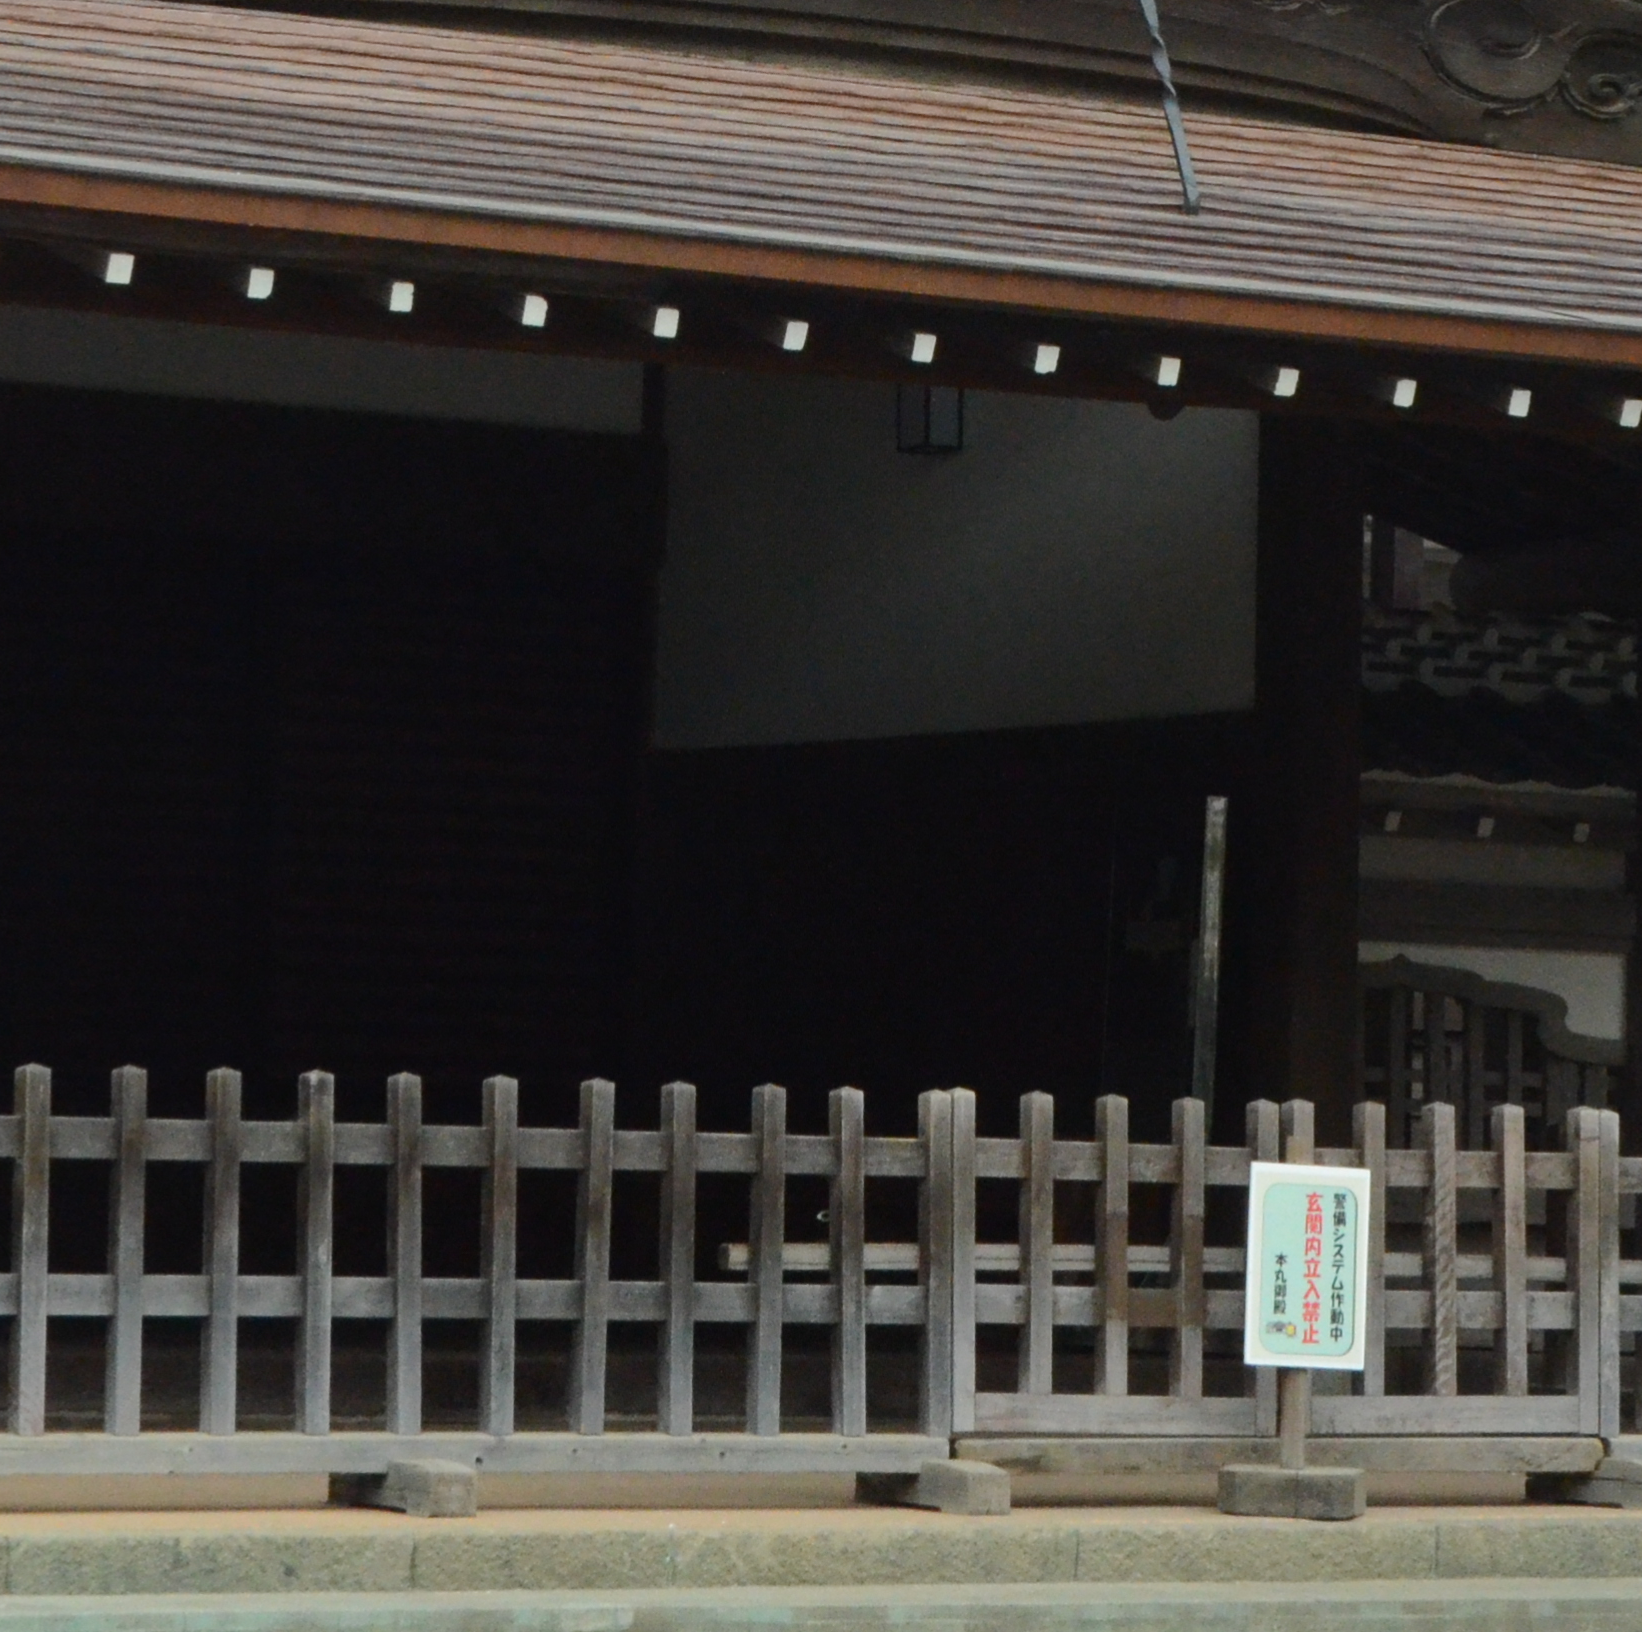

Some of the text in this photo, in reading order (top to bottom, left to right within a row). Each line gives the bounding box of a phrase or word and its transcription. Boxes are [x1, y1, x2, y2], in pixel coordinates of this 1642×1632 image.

[1273, 1251, 1288, 1315] 本丸御殿
[1301, 1191, 1324, 1345] 玄関内立入禁止
[1329, 1192, 1348, 1343] 警備システム作動中
